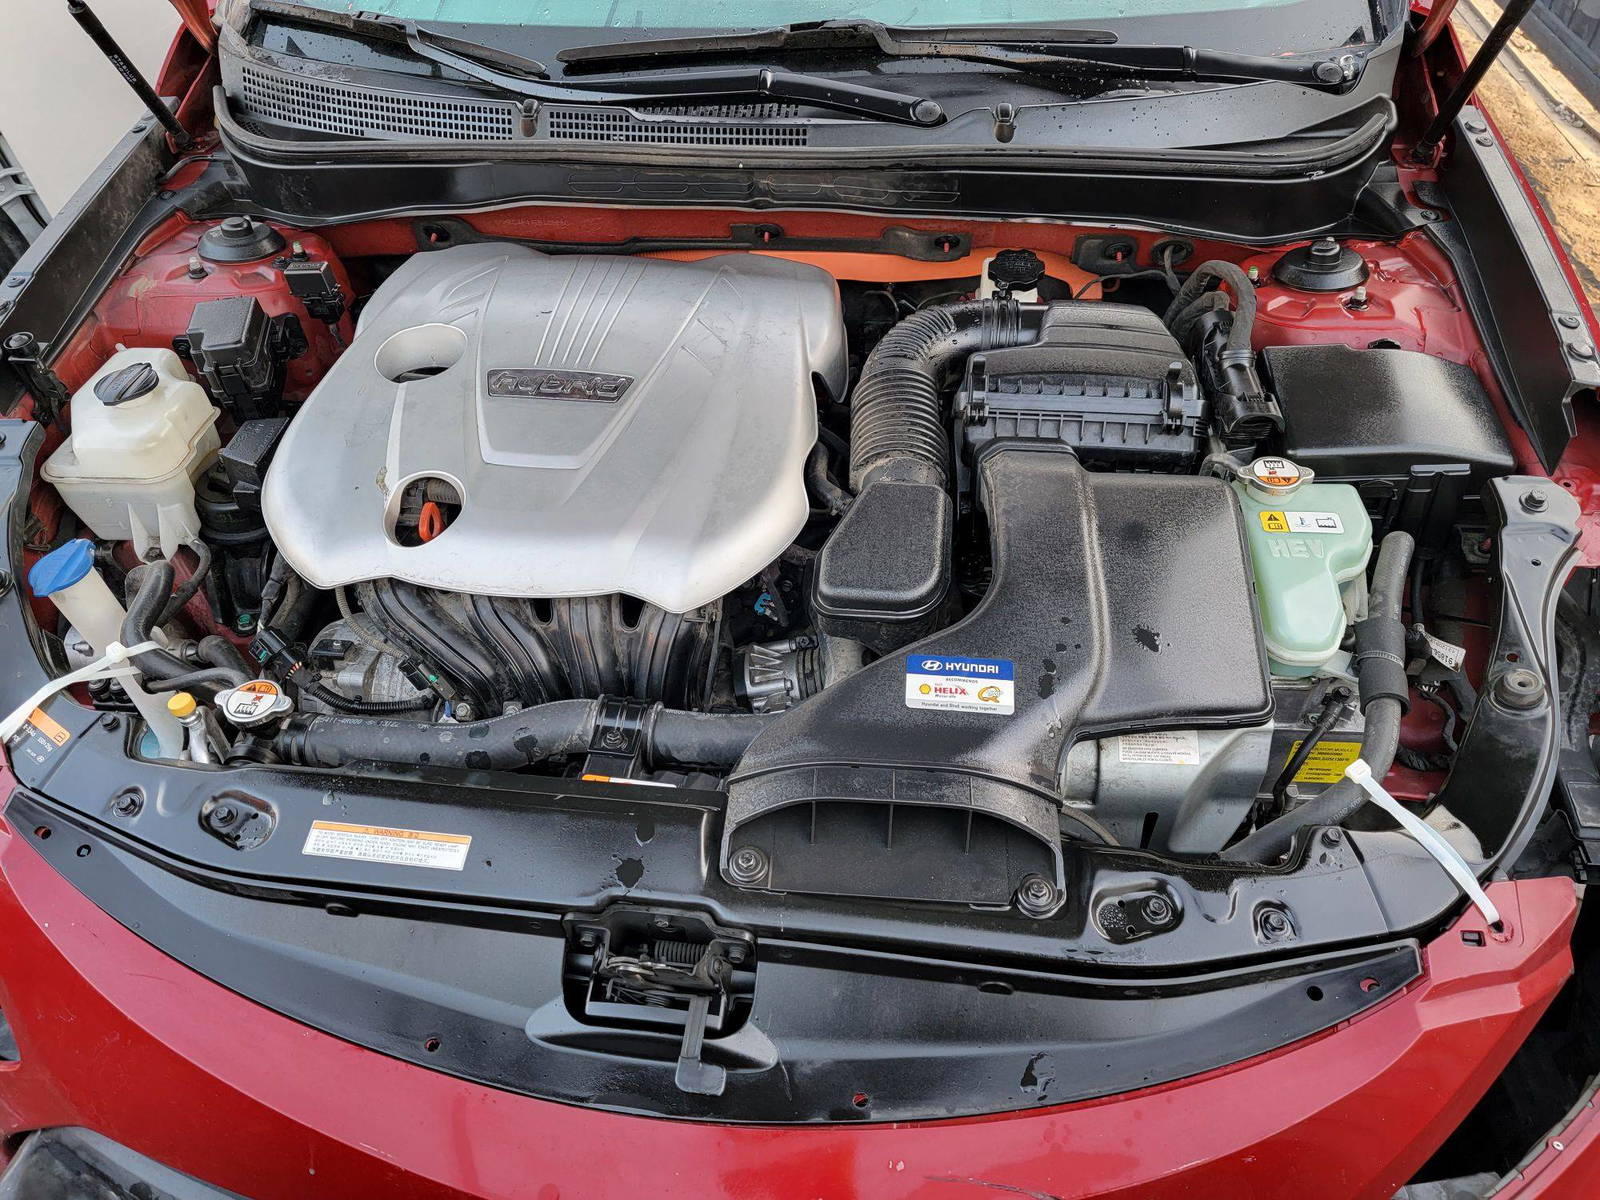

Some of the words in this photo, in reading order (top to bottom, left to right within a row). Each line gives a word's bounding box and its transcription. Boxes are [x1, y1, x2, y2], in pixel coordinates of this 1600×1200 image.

[492, 371, 626, 398] hybrid
[1268, 539, 1325, 558] HEV
[945, 661, 999, 674] HYUNDAI
[934, 686, 967, 695] HELIX
[373, 828, 405, 838] WARNING
